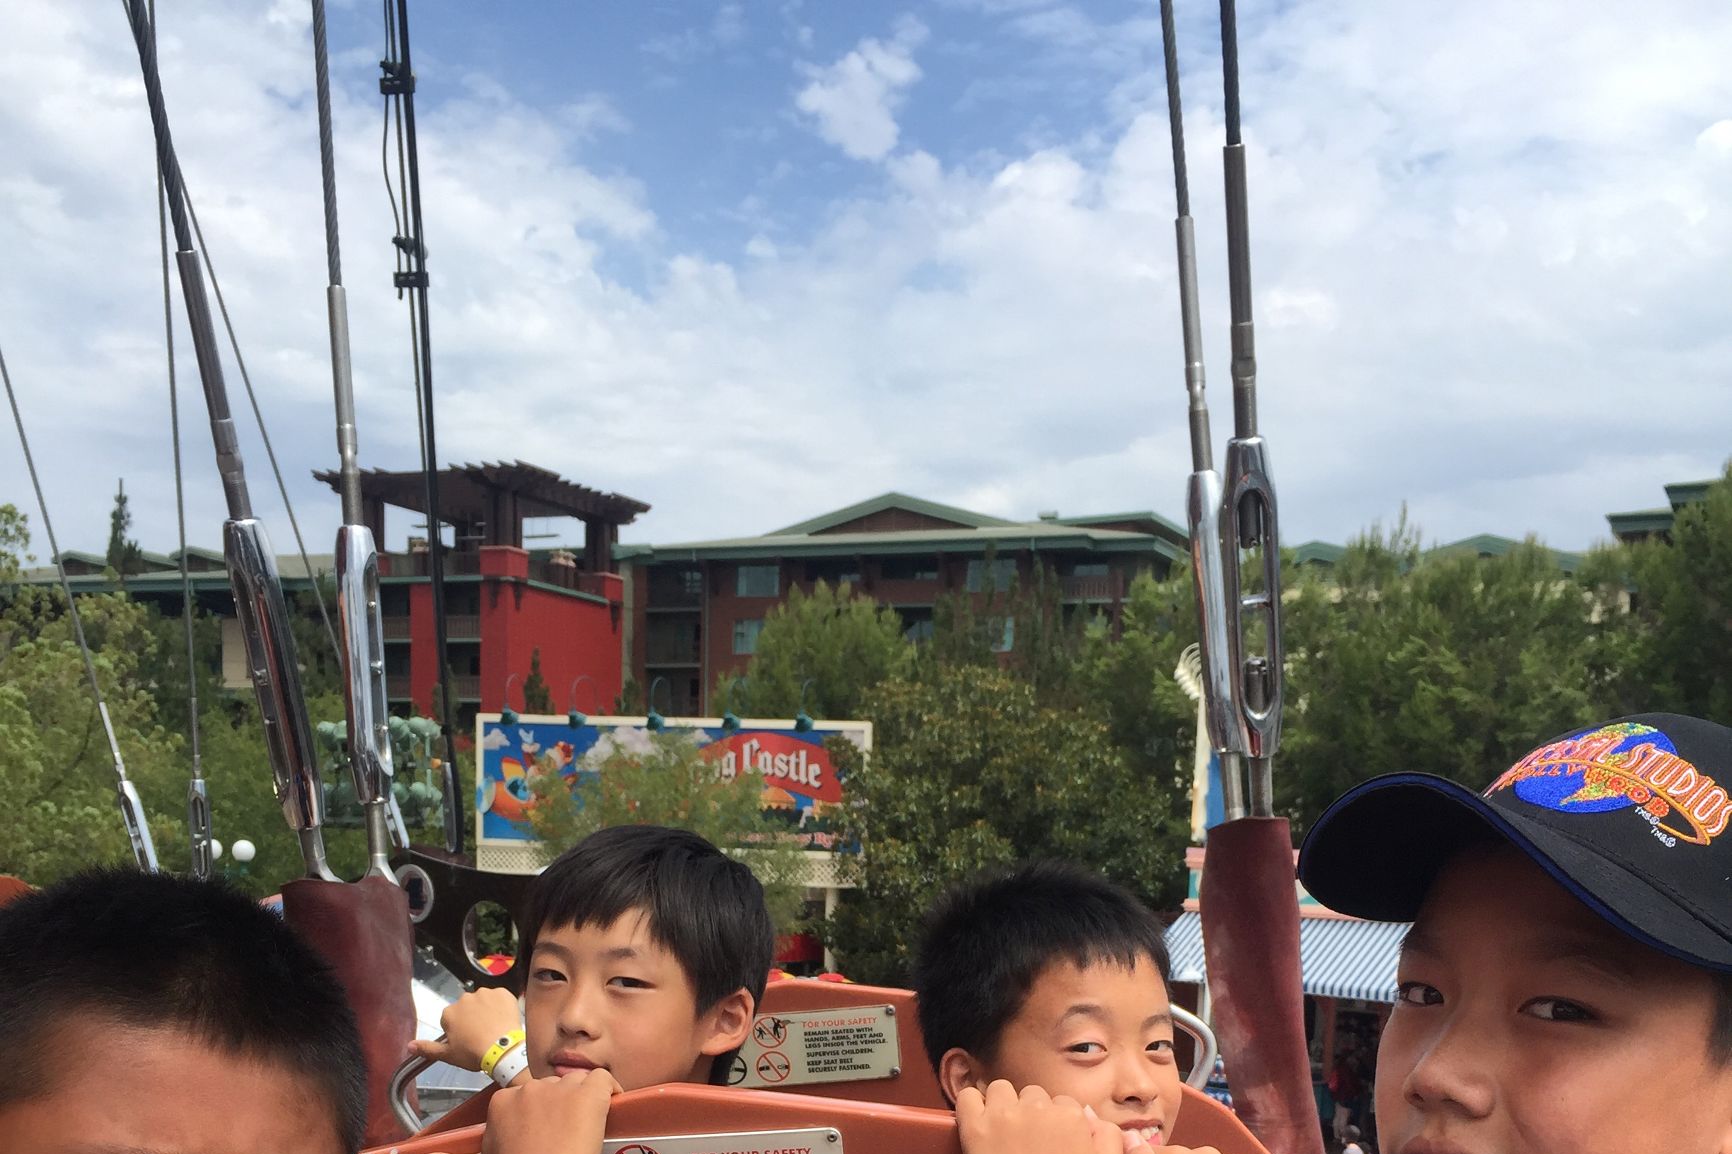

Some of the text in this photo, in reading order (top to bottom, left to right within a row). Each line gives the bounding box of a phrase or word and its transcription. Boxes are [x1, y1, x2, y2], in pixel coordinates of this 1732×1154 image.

[742, 738, 823, 788] Castle
[1619, 743, 1732, 837] STUDIOS
[848, 1017, 877, 1025] SAFETY
